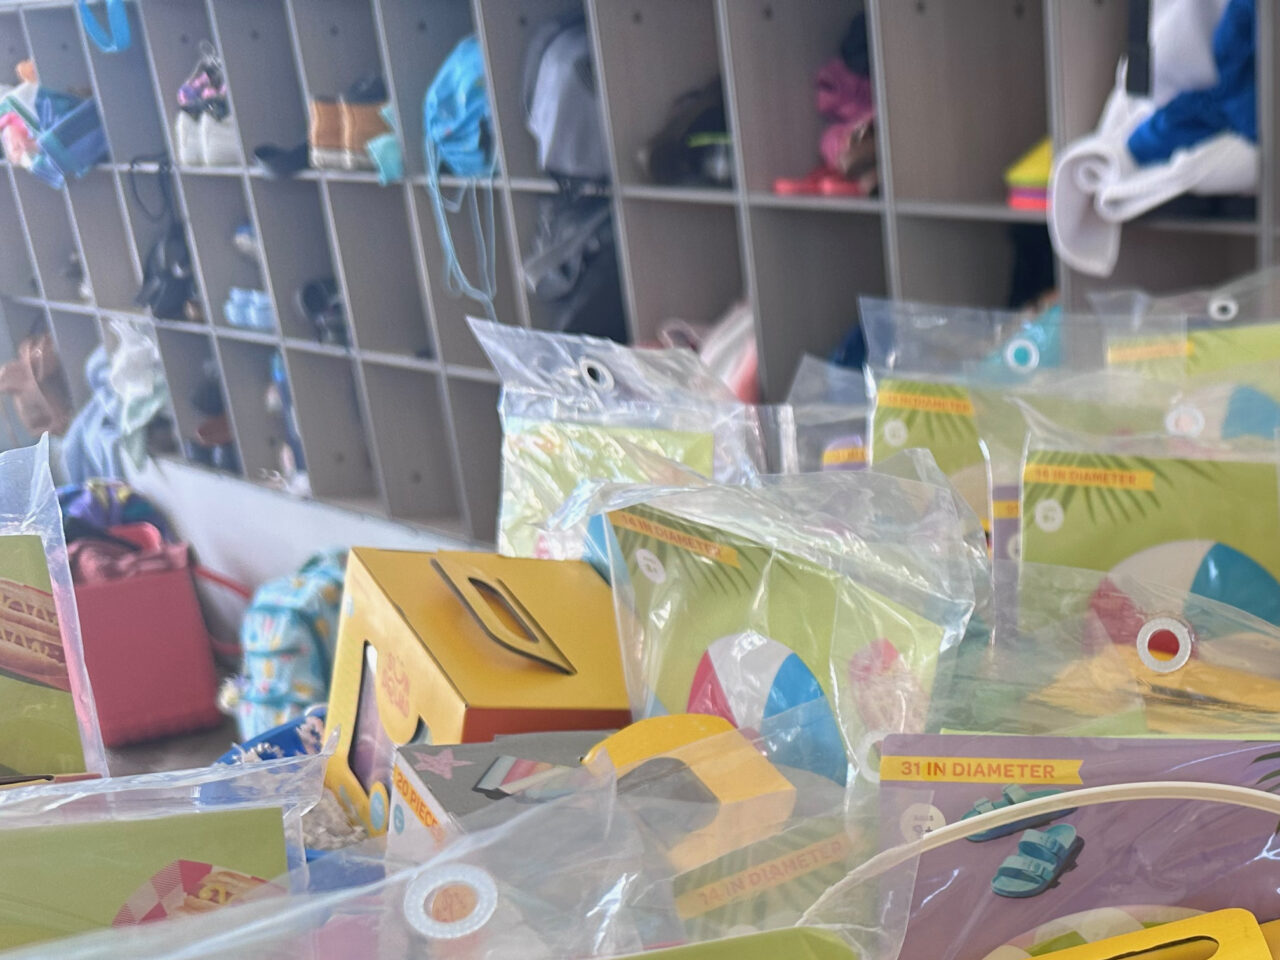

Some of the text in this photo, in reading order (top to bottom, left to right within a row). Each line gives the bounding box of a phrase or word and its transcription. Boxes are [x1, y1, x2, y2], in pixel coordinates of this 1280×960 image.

[1069, 468, 1137, 485] DIAMETER
[901, 761, 1055, 779] 31 IN DIAMETER
[396, 771, 409, 797] 20
[749, 840, 843, 886] DIAMETER
